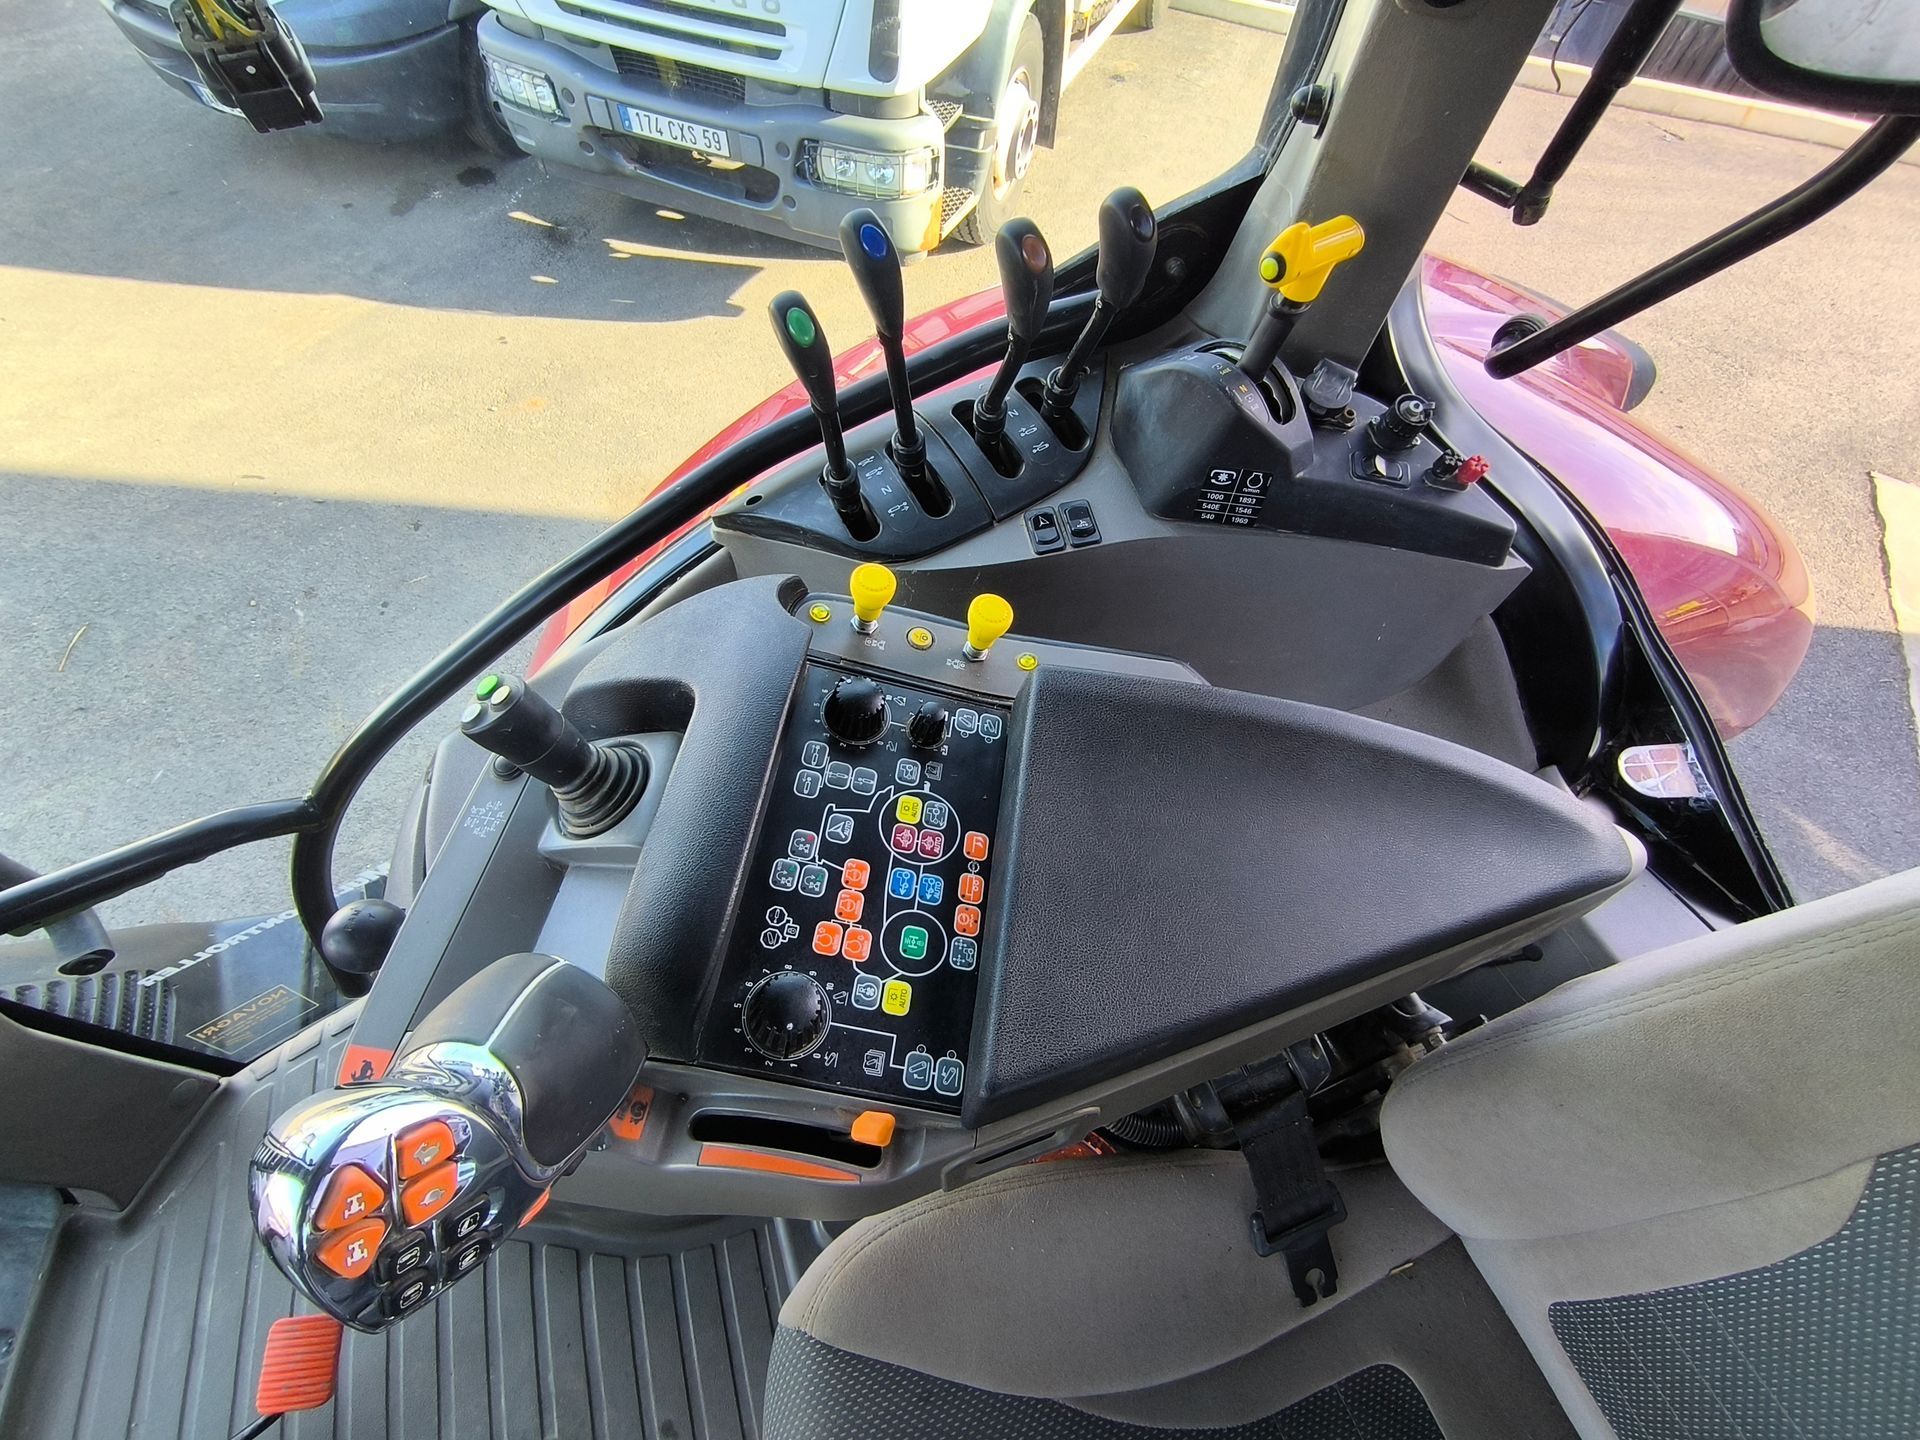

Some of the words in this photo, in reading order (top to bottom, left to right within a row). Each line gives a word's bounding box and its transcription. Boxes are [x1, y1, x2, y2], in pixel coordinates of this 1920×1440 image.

[635, 112, 663, 137] 174
[667, 120, 698, 145] CXS
[702, 128, 722, 151] 59
[1202, 503, 1220, 511] 540E
[1239, 496, 1256, 504] 1893
[911, 801, 919, 818] AUTO
[843, 820, 852, 836] AUTO
[933, 836, 942, 853] AUTO
[933, 882, 942, 898] AUTO
[826, 982, 835, 991] 10
[899, 988, 908, 1008] AUTO
